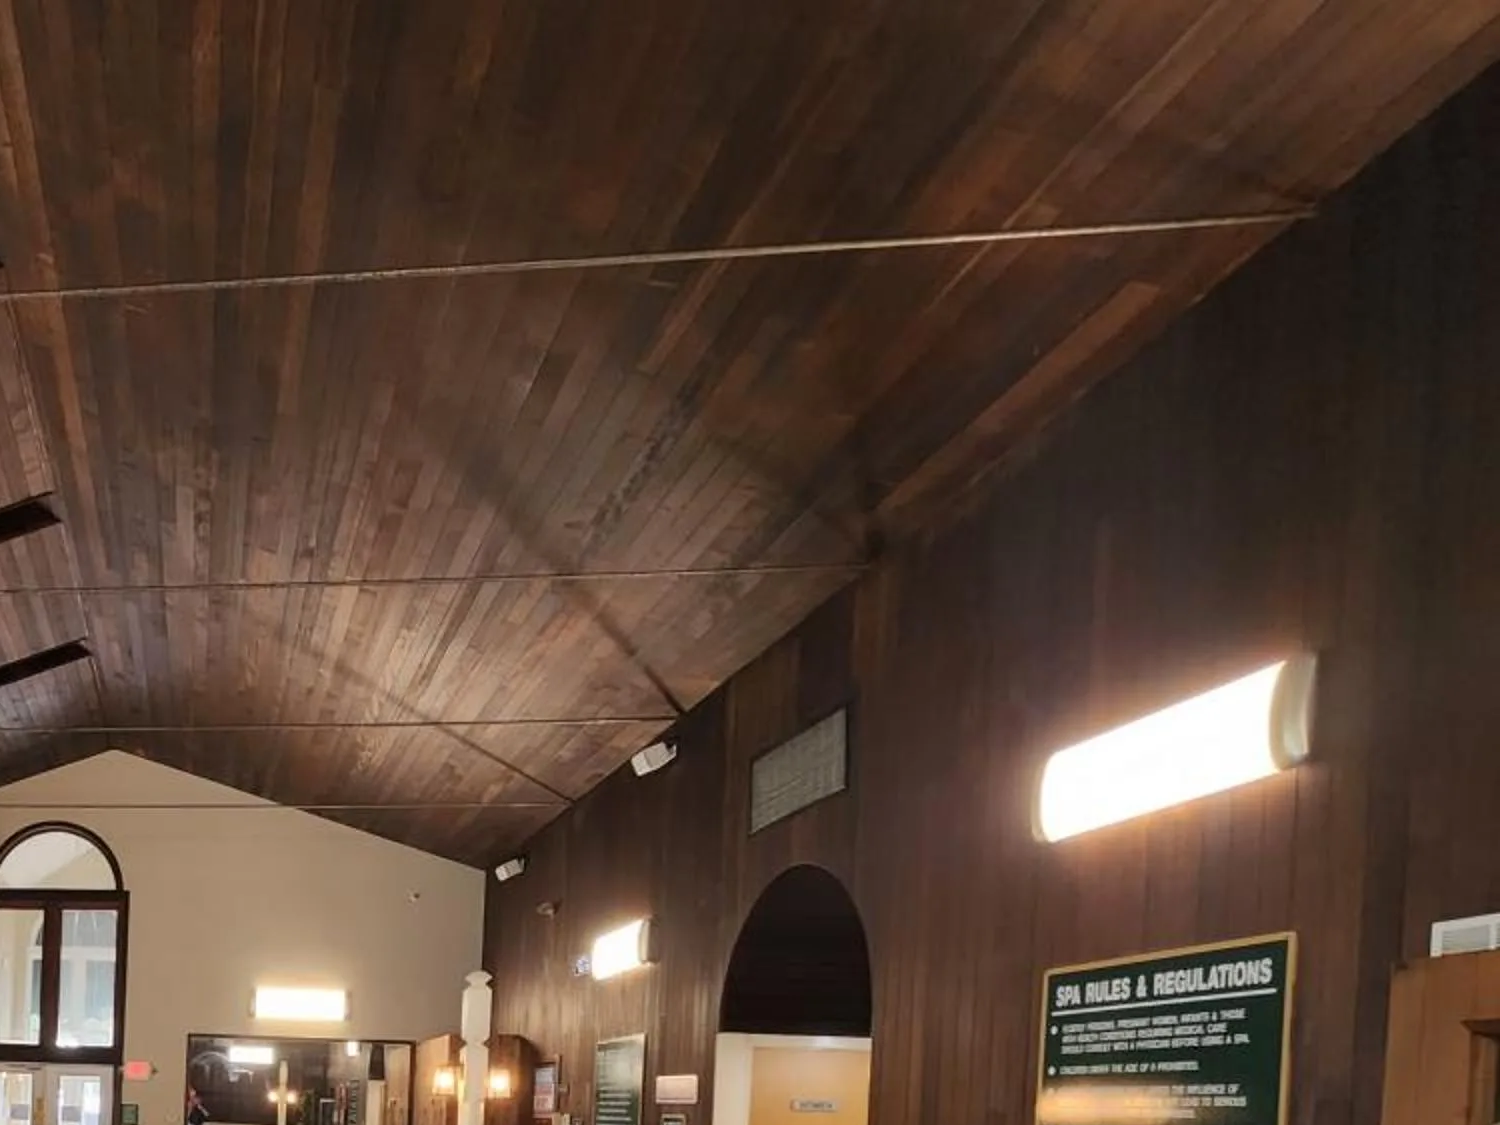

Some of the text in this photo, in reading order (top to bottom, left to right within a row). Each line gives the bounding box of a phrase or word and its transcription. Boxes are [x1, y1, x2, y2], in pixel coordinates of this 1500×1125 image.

[1055, 957, 1273, 1007] SPA RULES & REGULATIONS
